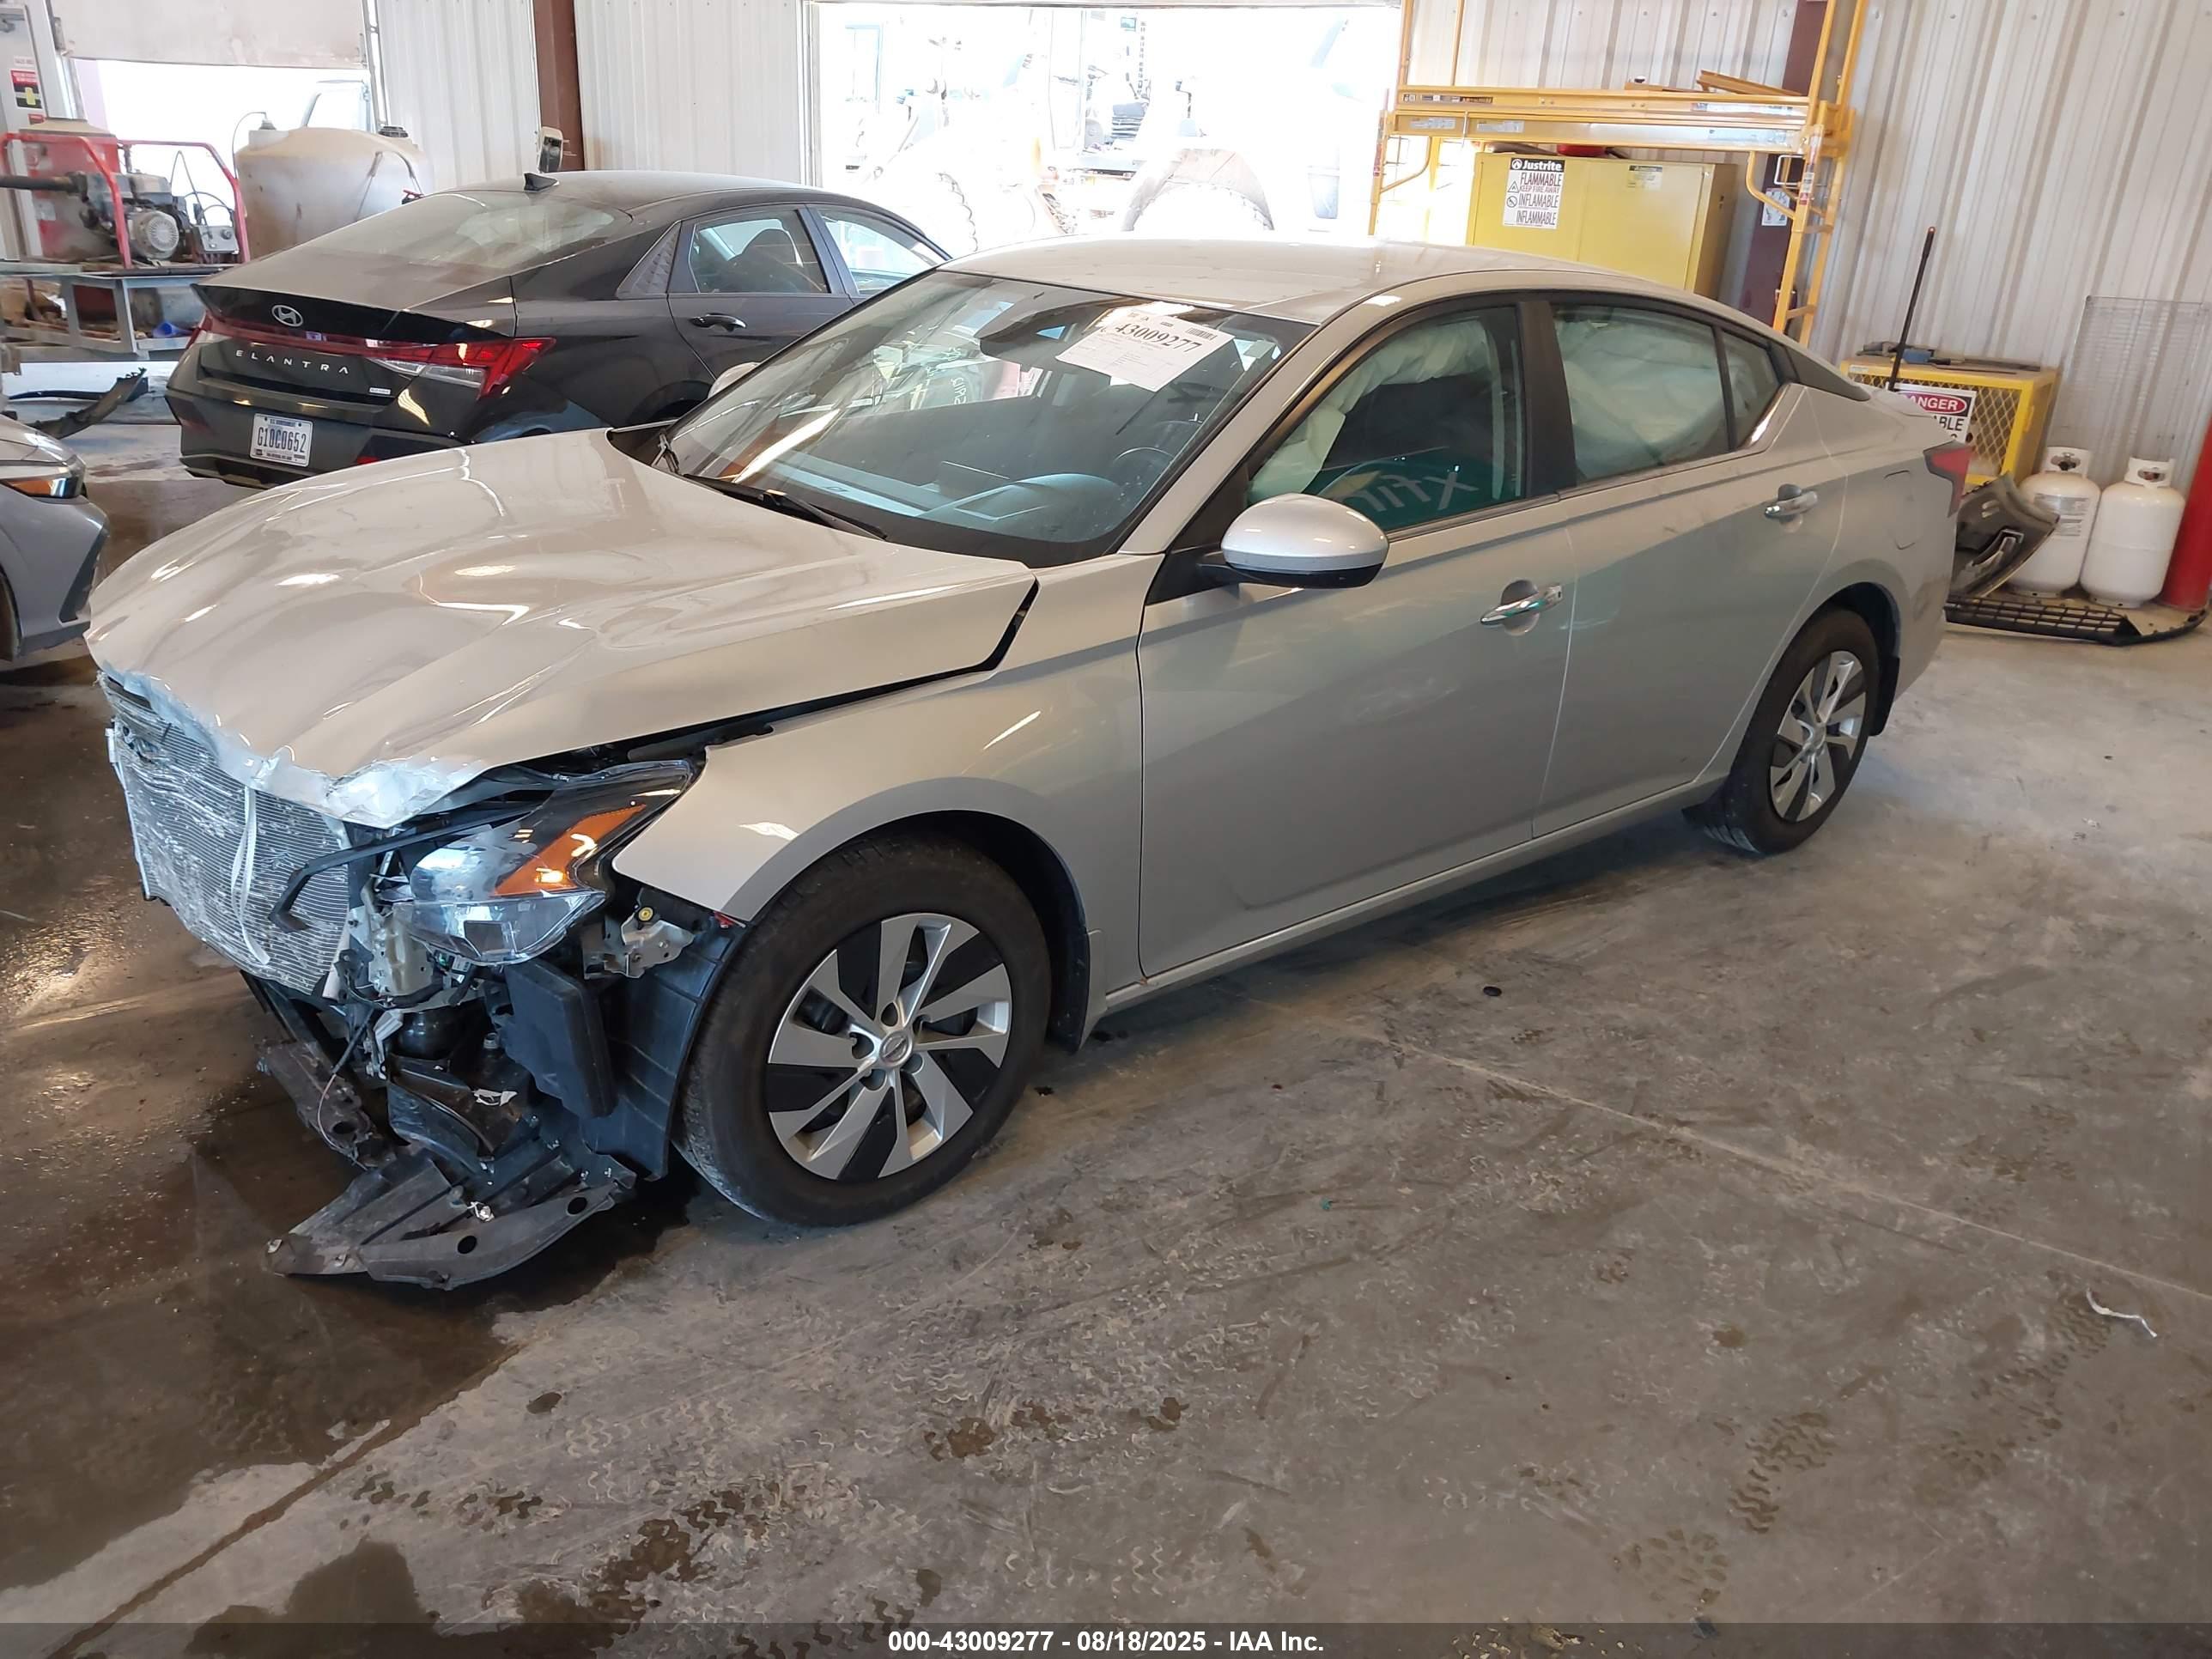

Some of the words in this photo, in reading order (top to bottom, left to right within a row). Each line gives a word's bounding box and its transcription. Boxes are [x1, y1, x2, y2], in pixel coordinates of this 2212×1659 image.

[1522, 160, 1563, 171] Justrite
[1520, 172, 1562, 186] FLAMMABLE
[1519, 193, 1559, 208] INFLAMABLE
[1516, 210, 1557, 225] INFLAMMABLE
[1115, 323, 1202, 353] 43009277
[235, 349, 349, 374] ELANTRA
[1909, 395, 1959, 411] ANGER
